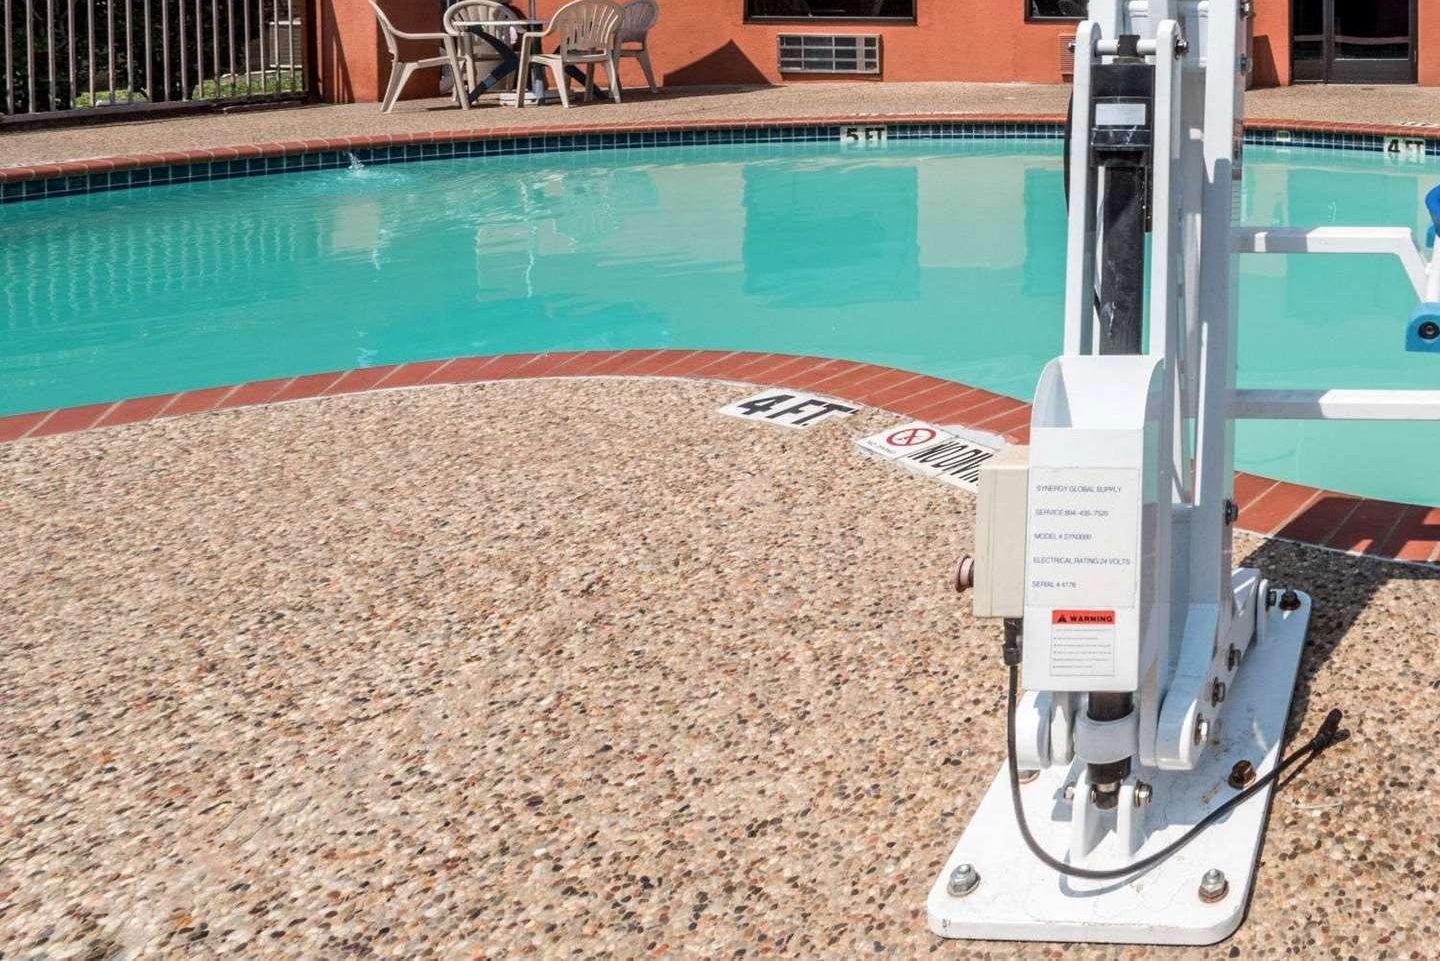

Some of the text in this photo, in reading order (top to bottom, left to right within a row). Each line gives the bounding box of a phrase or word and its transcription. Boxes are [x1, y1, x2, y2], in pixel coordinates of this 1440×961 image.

[846, 127, 859, 140] 5
[1387, 139, 1400, 153] 4
[738, 394, 796, 415] 4
[907, 440, 968, 463] NO
[1033, 556, 1072, 564] ELECTRICAL
[1032, 580, 1054, 588] SERIAL
[1070, 615, 1113, 623] WARNING
